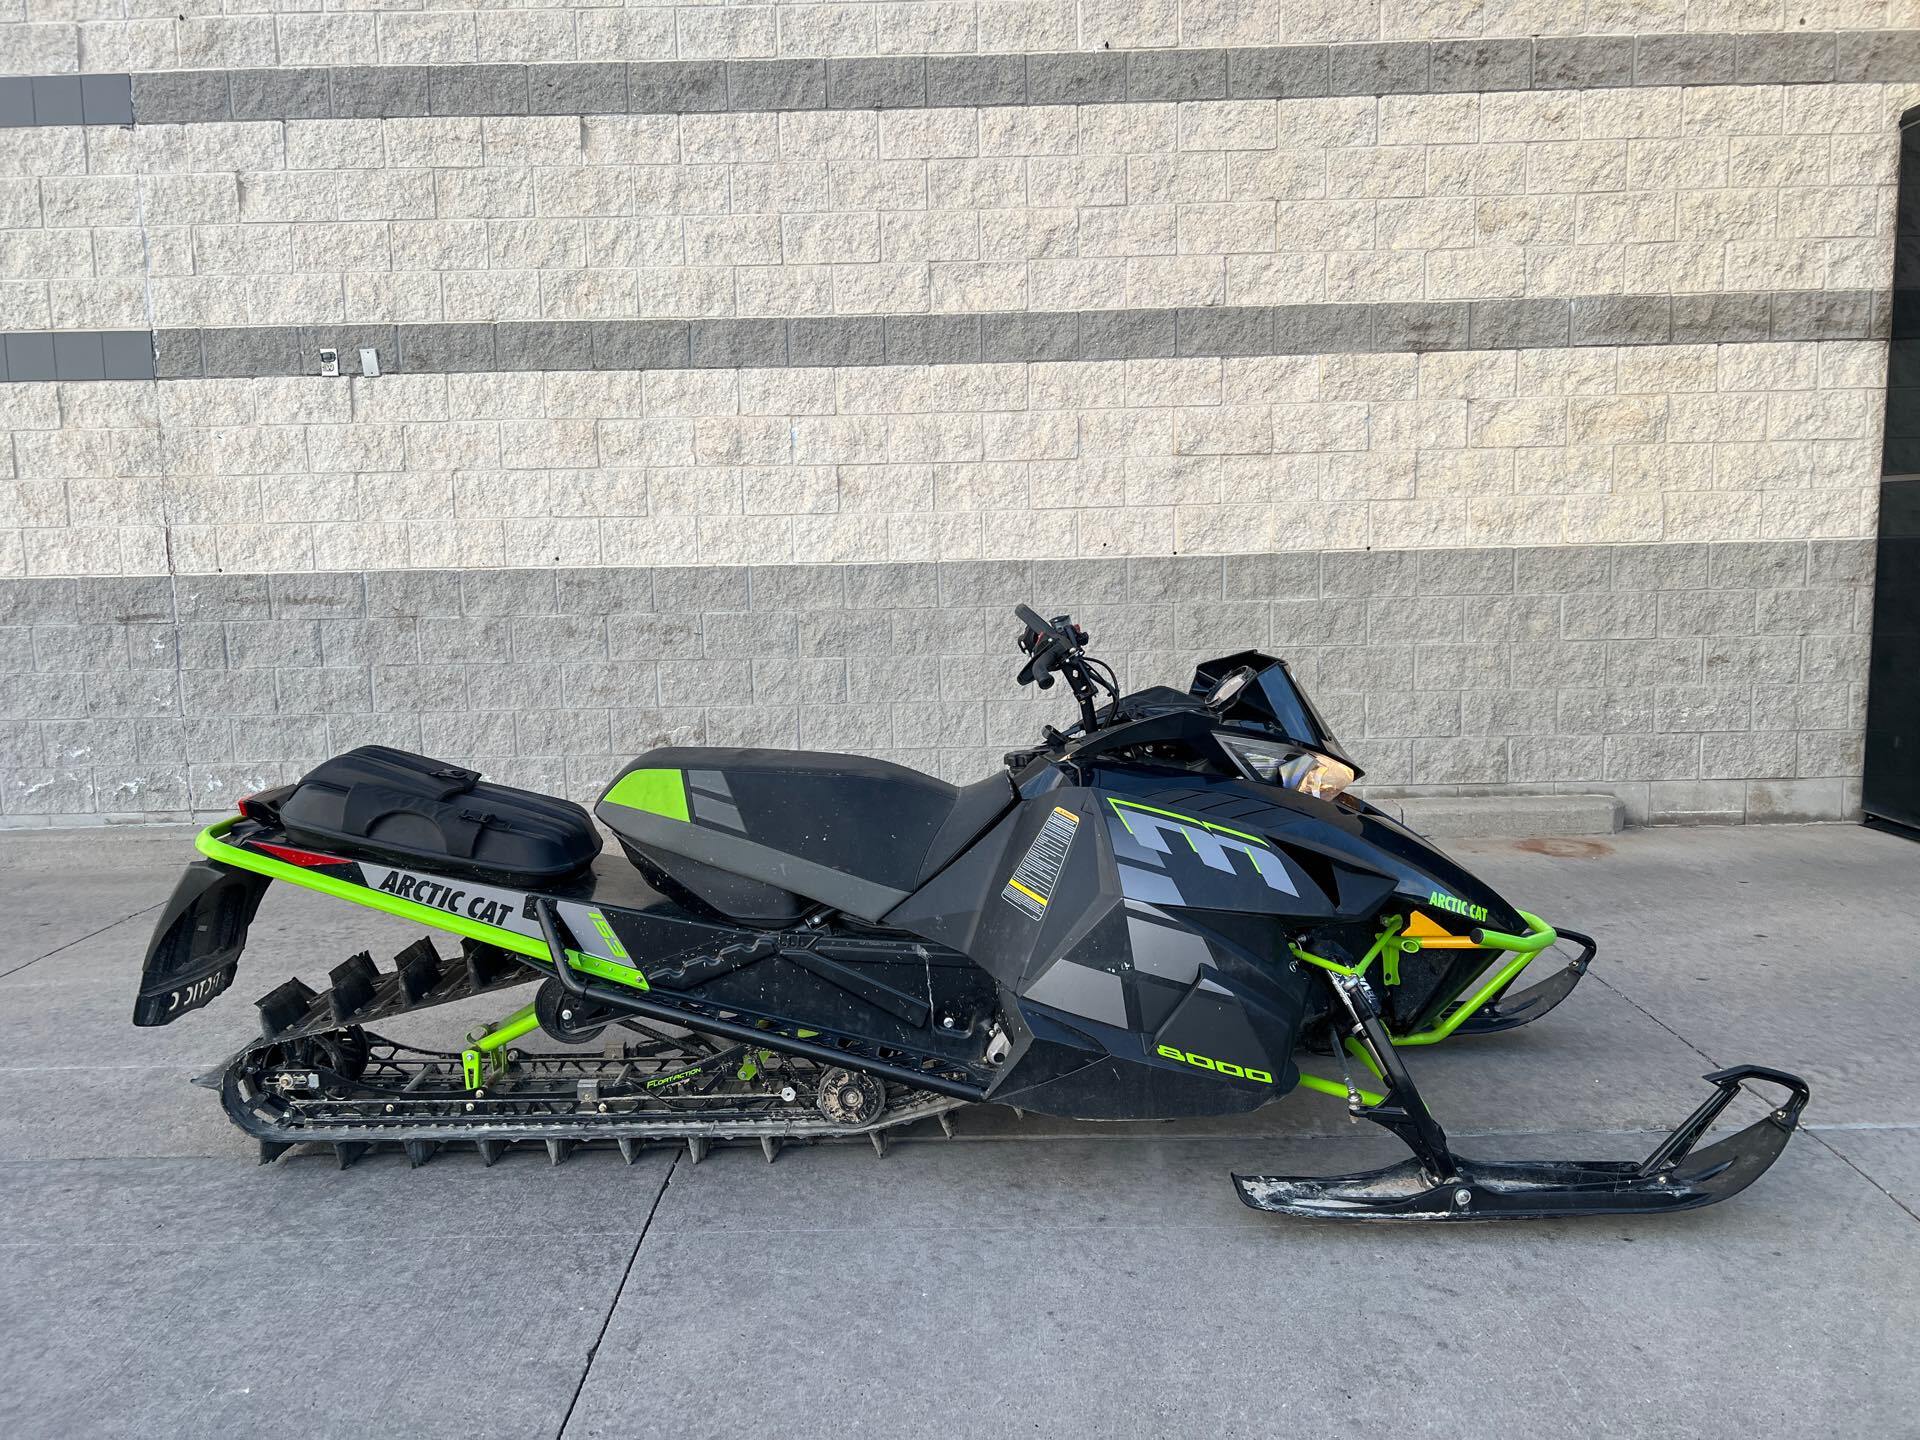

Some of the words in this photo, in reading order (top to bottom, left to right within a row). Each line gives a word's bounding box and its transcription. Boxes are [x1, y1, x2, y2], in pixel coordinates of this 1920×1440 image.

[379, 870, 466, 912] ARCTIC
[467, 896, 514, 926] CAT
[1429, 891, 1468, 915] ARCTIC
[1470, 904, 1488, 922] CAT
[587, 912, 627, 957] 153
[1157, 1044, 1273, 1083] 8000
